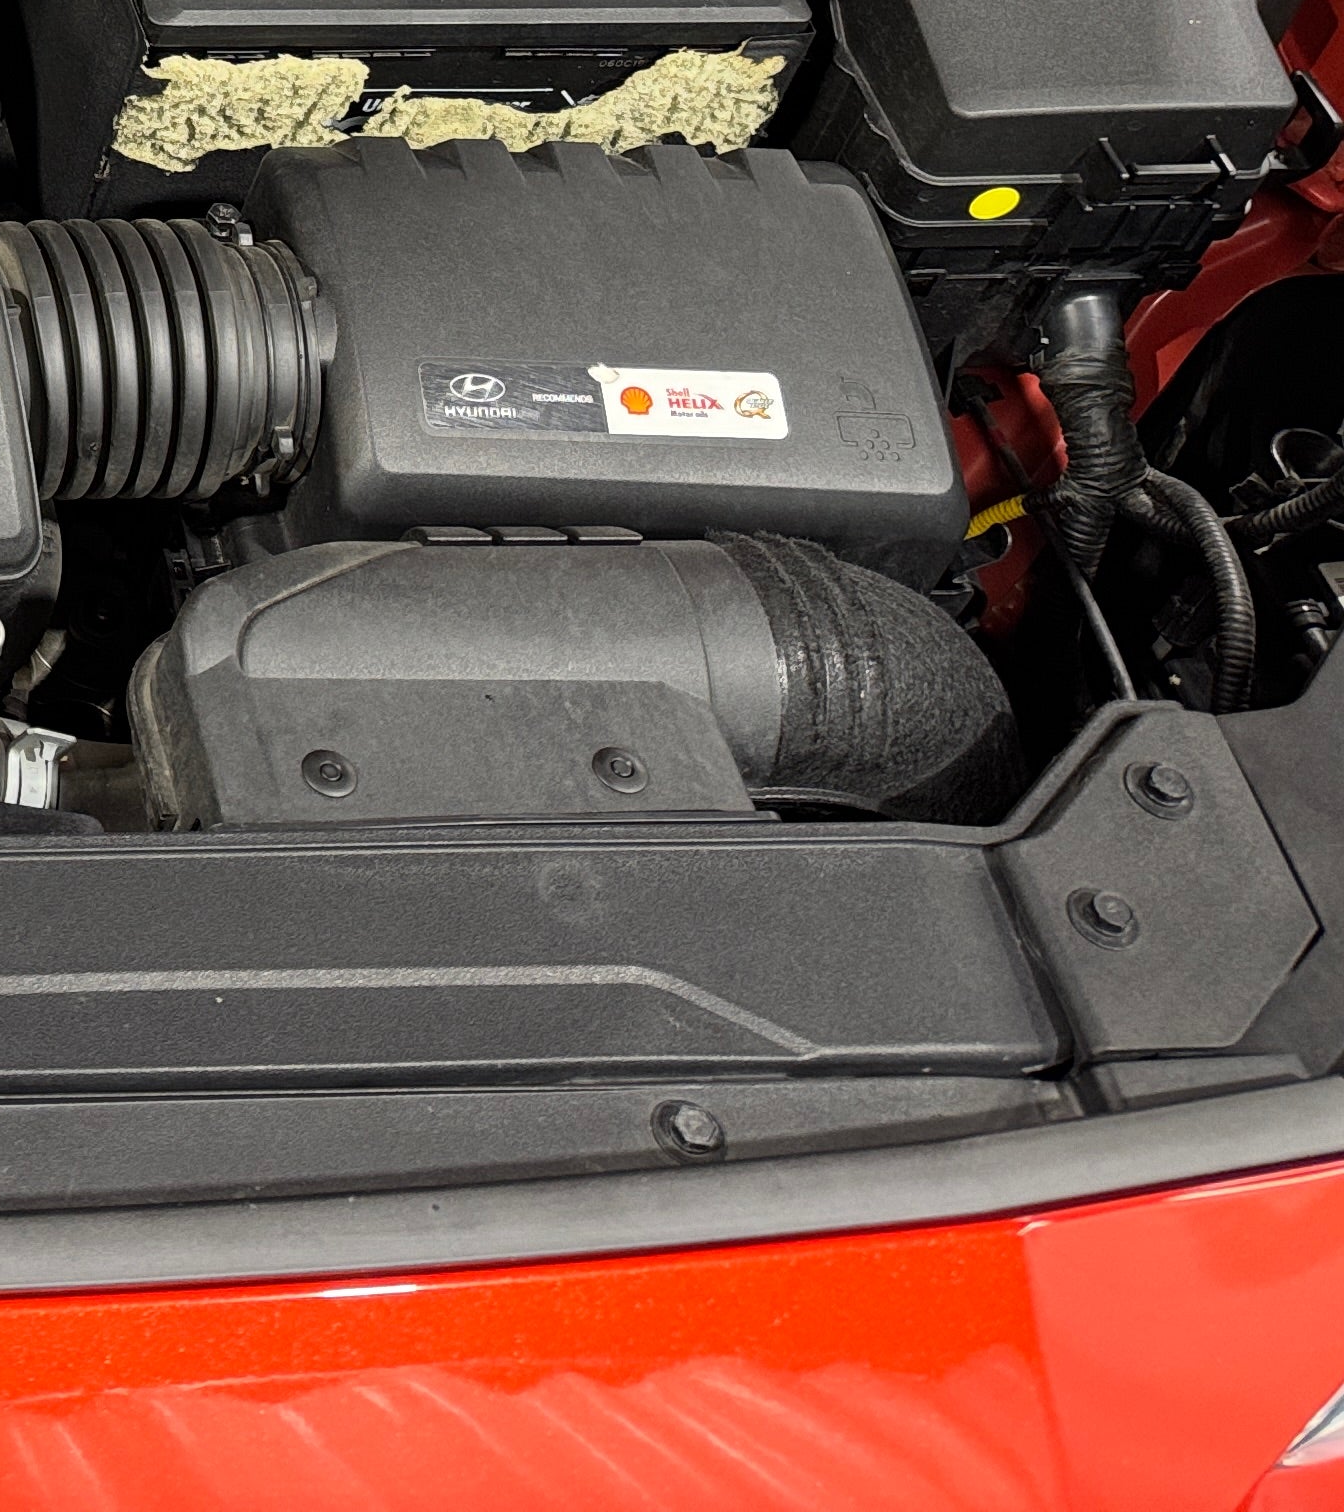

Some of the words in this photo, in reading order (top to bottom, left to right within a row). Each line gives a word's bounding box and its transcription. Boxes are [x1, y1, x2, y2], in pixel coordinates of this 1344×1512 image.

[532, 393, 594, 403] RECOMMENDS
[666, 388, 690, 398] Shell
[668, 397, 724, 410] HELIX
[445, 405, 517, 419] HYUNDAI
